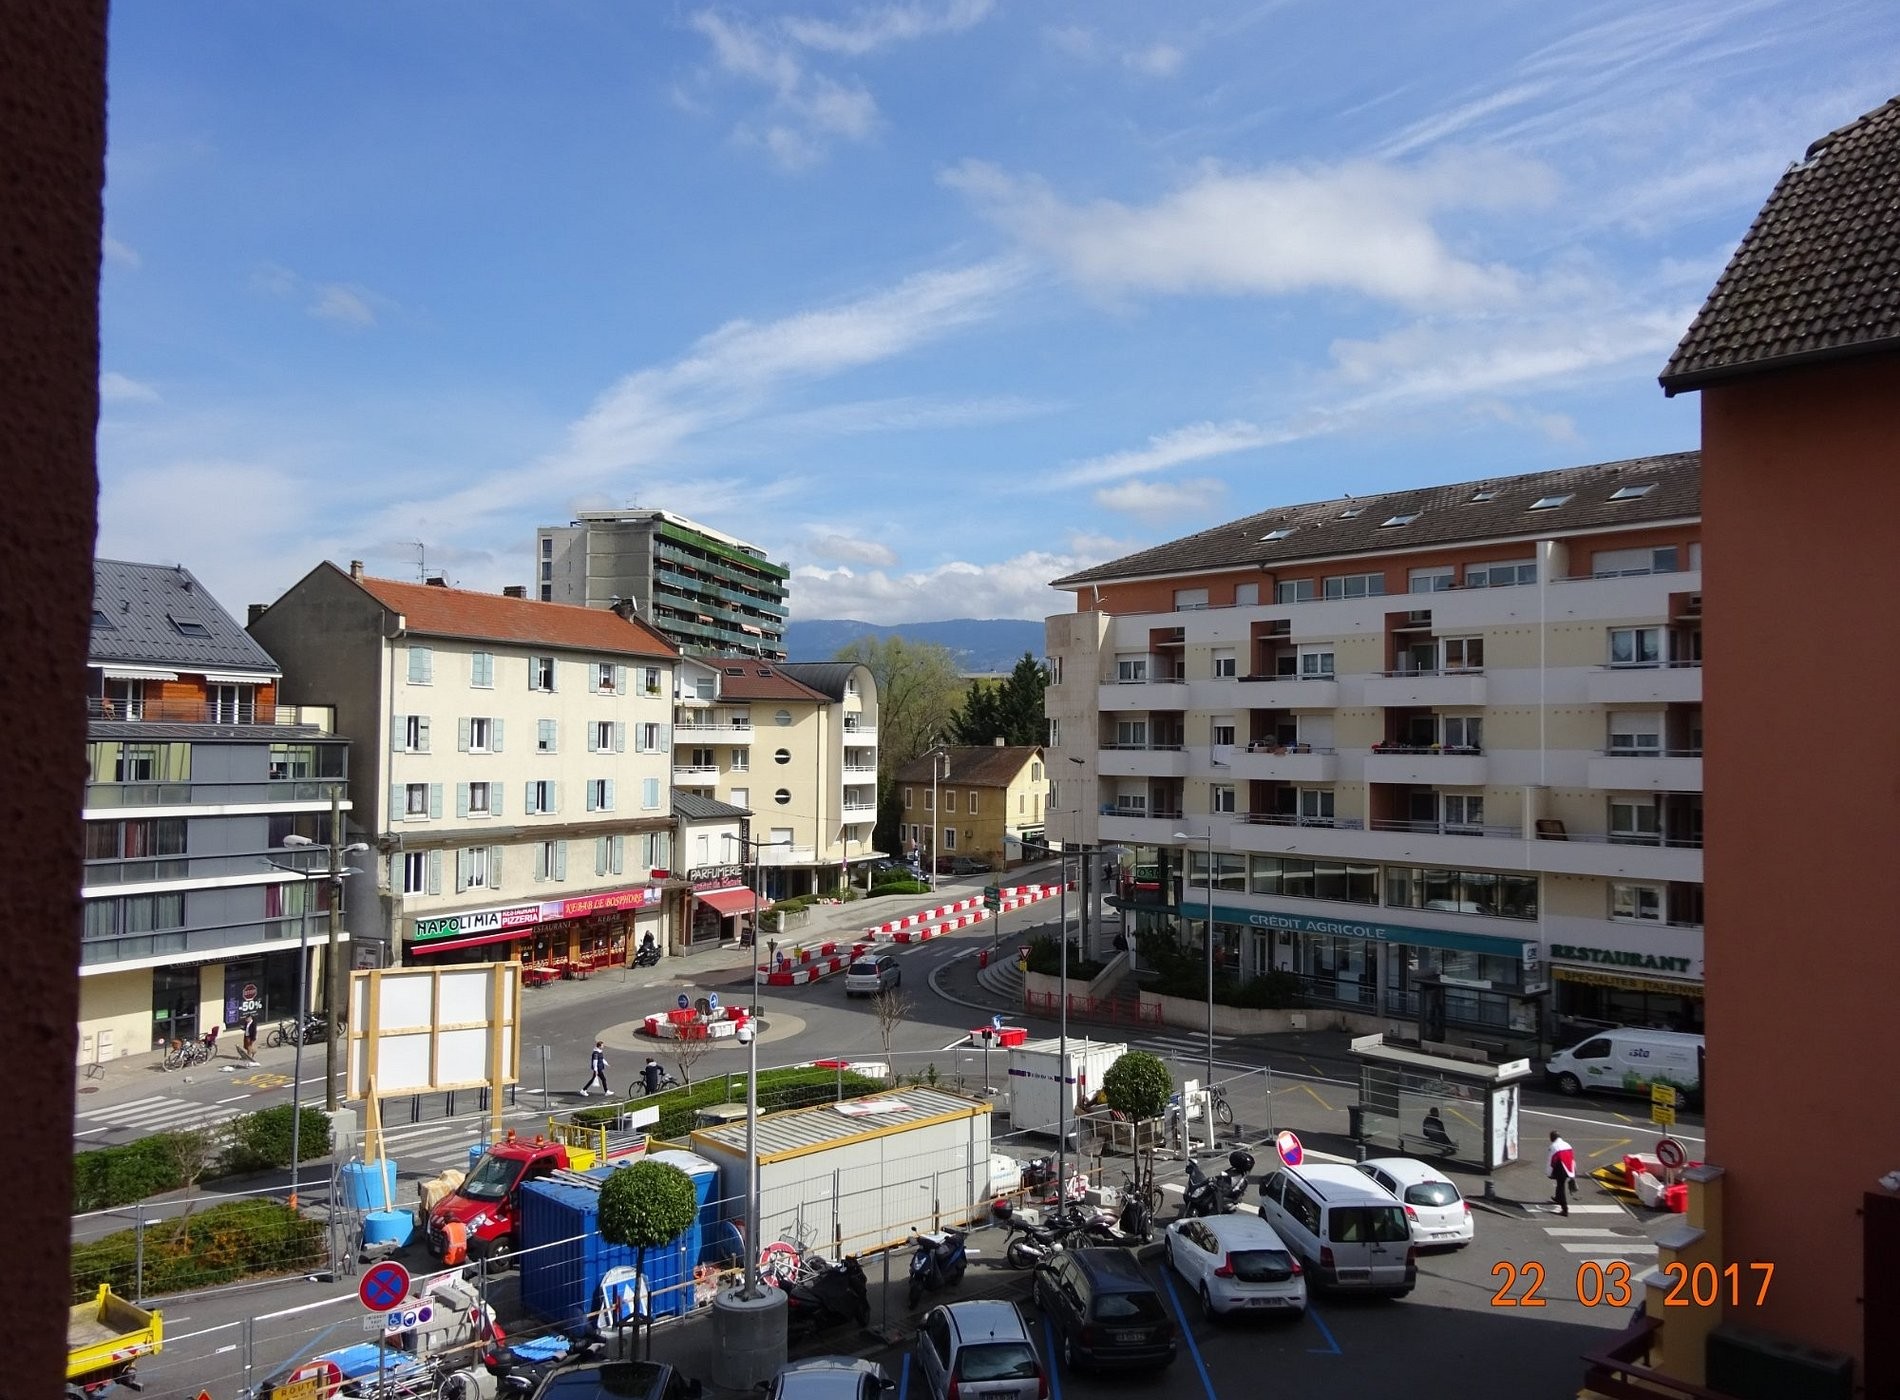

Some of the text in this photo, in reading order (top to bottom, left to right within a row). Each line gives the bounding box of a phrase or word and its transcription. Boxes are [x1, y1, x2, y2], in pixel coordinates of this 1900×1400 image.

[690, 865, 742, 880] PARFUMERIE
[565, 892, 643, 914] KEBAB LE BOSPHORE
[417, 914, 498, 936] NAPOLI MIA
[502, 914, 538, 926] PIZZERIA
[533, 921, 571, 933] ESTAURANT
[1249, 914, 1386, 939] CRÉDIT AGRICOLE
[1550, 944, 1690, 973] RESTAURANT
[239, 1000, 262, 1012] -50%
